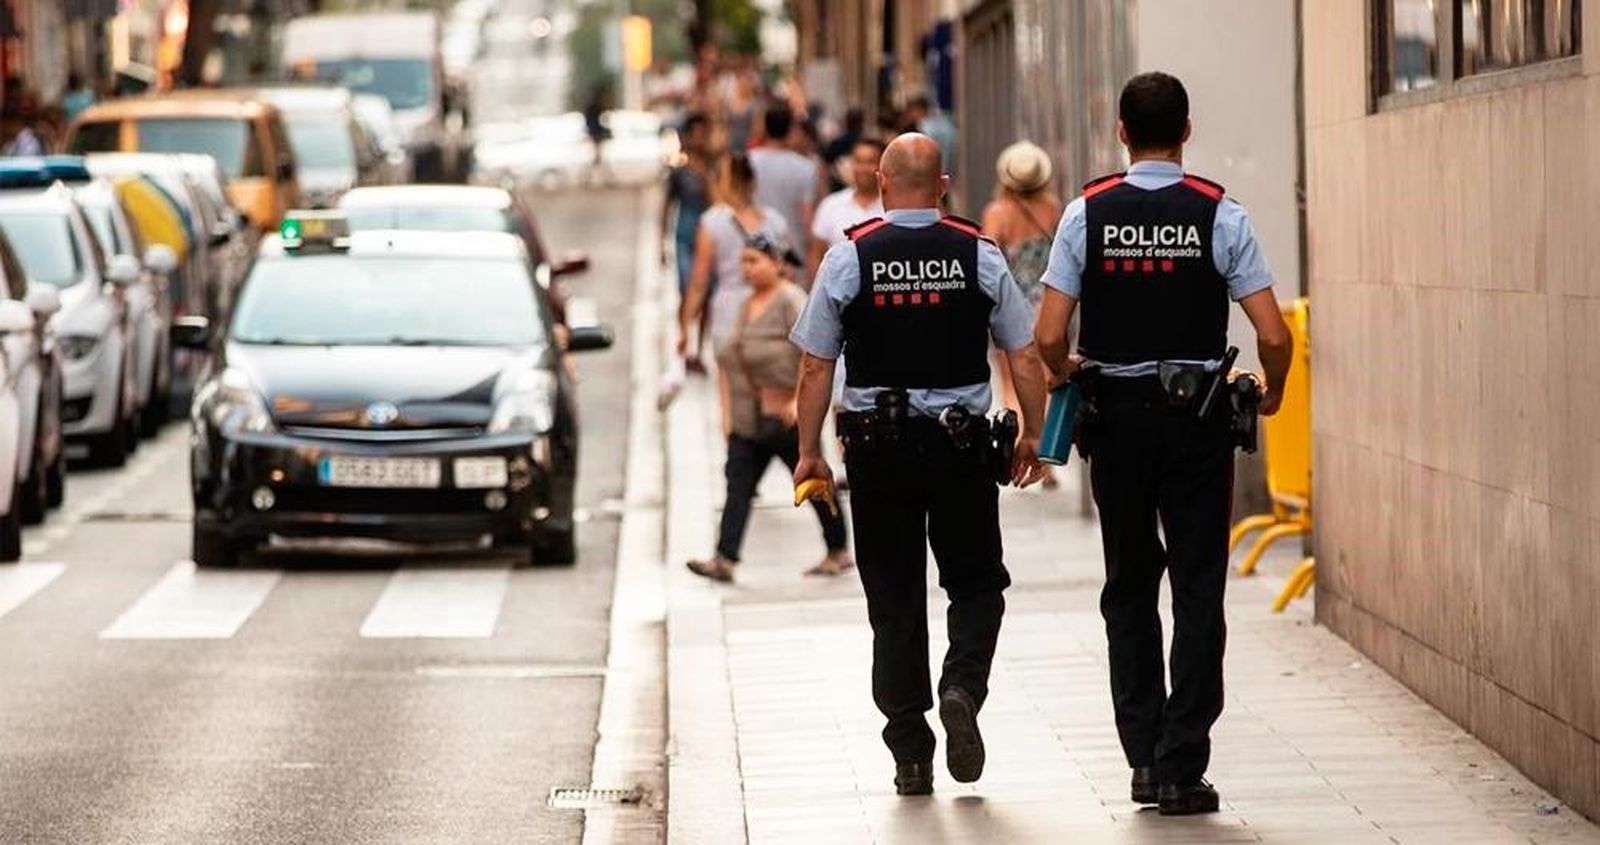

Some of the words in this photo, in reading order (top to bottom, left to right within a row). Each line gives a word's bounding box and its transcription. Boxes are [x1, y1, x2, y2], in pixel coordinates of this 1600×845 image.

[1103, 225, 1201, 246] POLICIA
[1103, 248, 1144, 257] mossos
[1145, 247, 1202, 259] d'esquadra
[872, 258, 965, 281] POLICIA
[873, 282, 912, 293] mossos
[912, 280, 966, 292] d'esquadra
